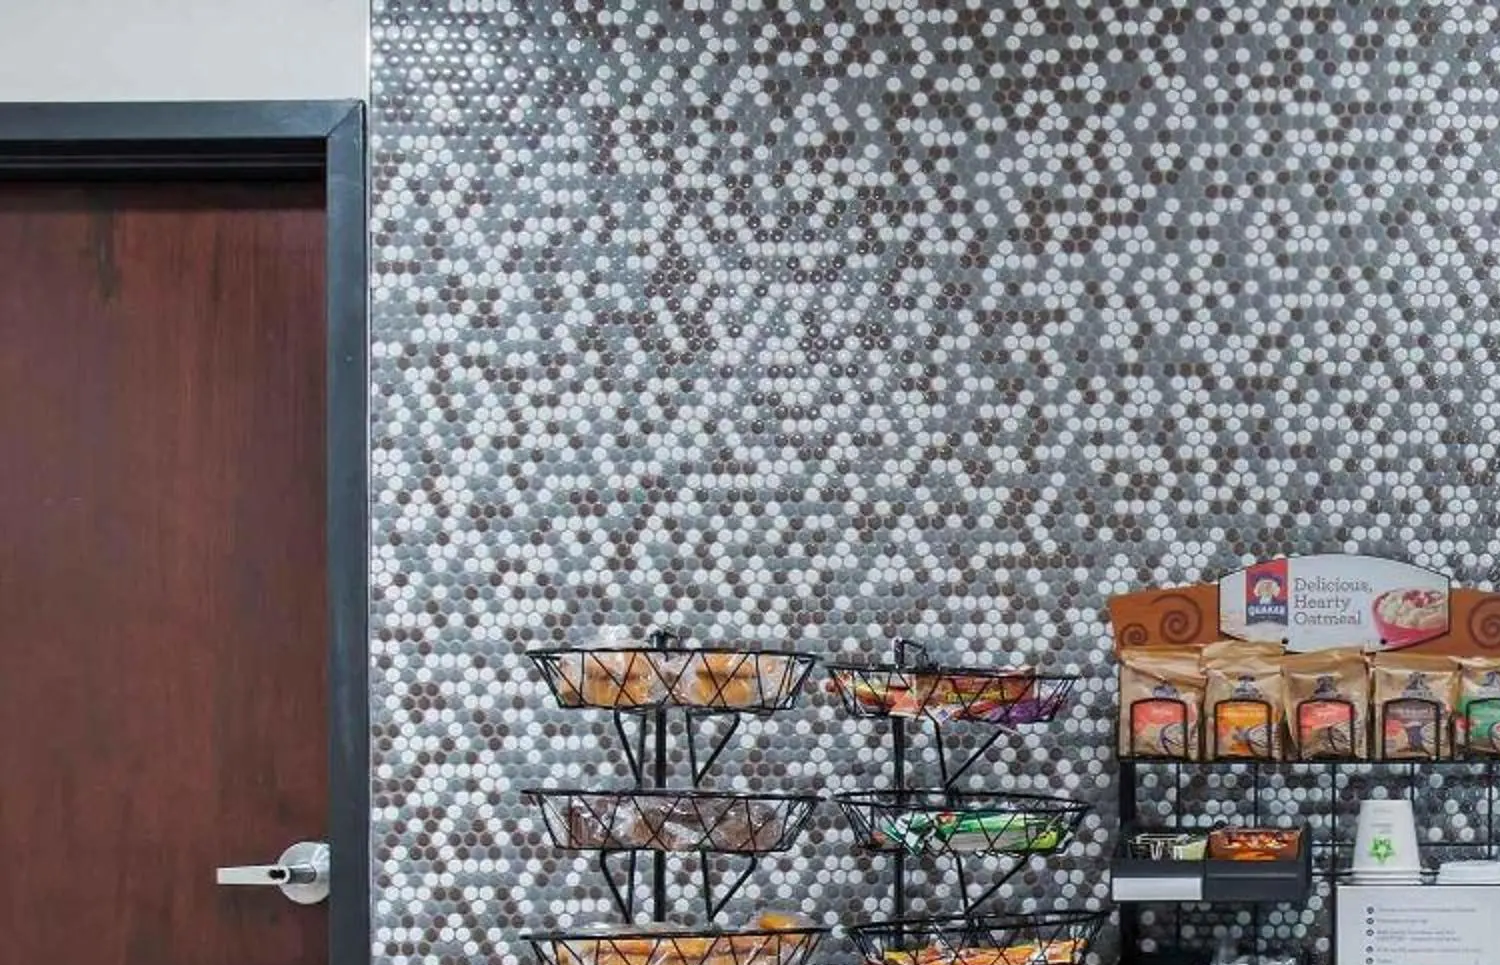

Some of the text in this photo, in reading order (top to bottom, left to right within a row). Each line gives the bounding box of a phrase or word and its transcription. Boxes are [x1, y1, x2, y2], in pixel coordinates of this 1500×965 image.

[1294, 576, 1373, 593] Delicious,
[1294, 594, 1351, 612] Hearty
[1294, 611, 1361, 625] Oatmeal
